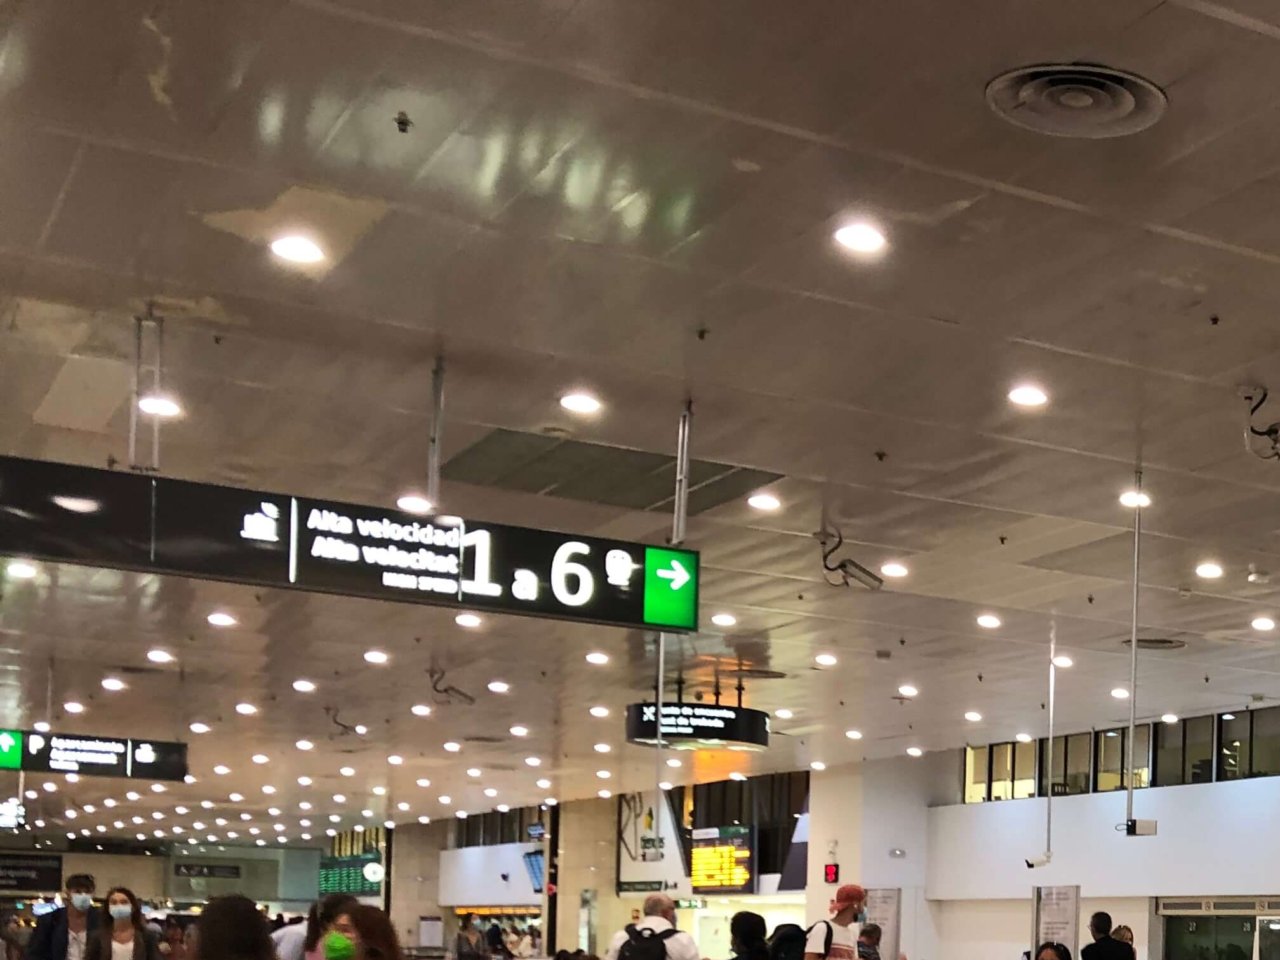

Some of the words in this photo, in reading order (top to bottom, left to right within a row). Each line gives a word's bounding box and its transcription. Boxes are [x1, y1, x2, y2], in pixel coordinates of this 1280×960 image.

[307, 508, 353, 534] Alta
[356, 518, 461, 548] velocidad
[550, 541, 595, 606] 6
